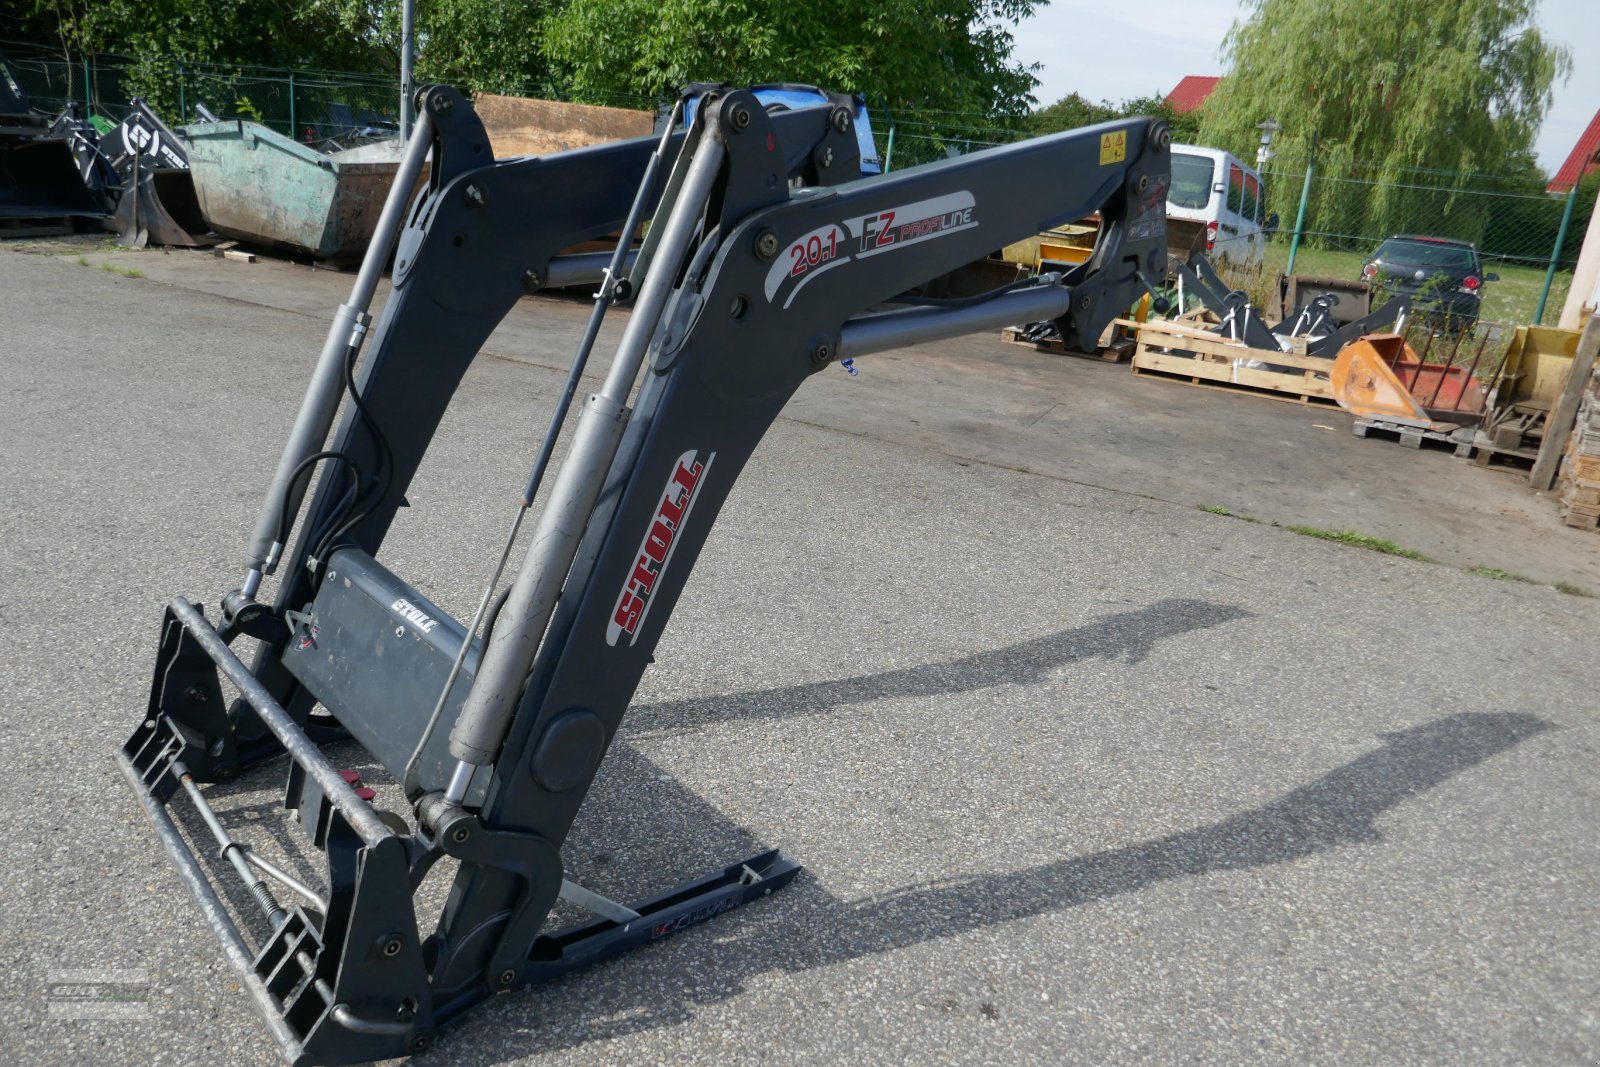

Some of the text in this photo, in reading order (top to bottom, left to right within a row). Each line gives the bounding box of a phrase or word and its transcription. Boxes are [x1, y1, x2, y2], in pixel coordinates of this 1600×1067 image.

[790, 208, 973, 277] 20.1 FZ PROFILINE
[614, 460, 704, 634] STOLL
[391, 598, 439, 634] STOLL
